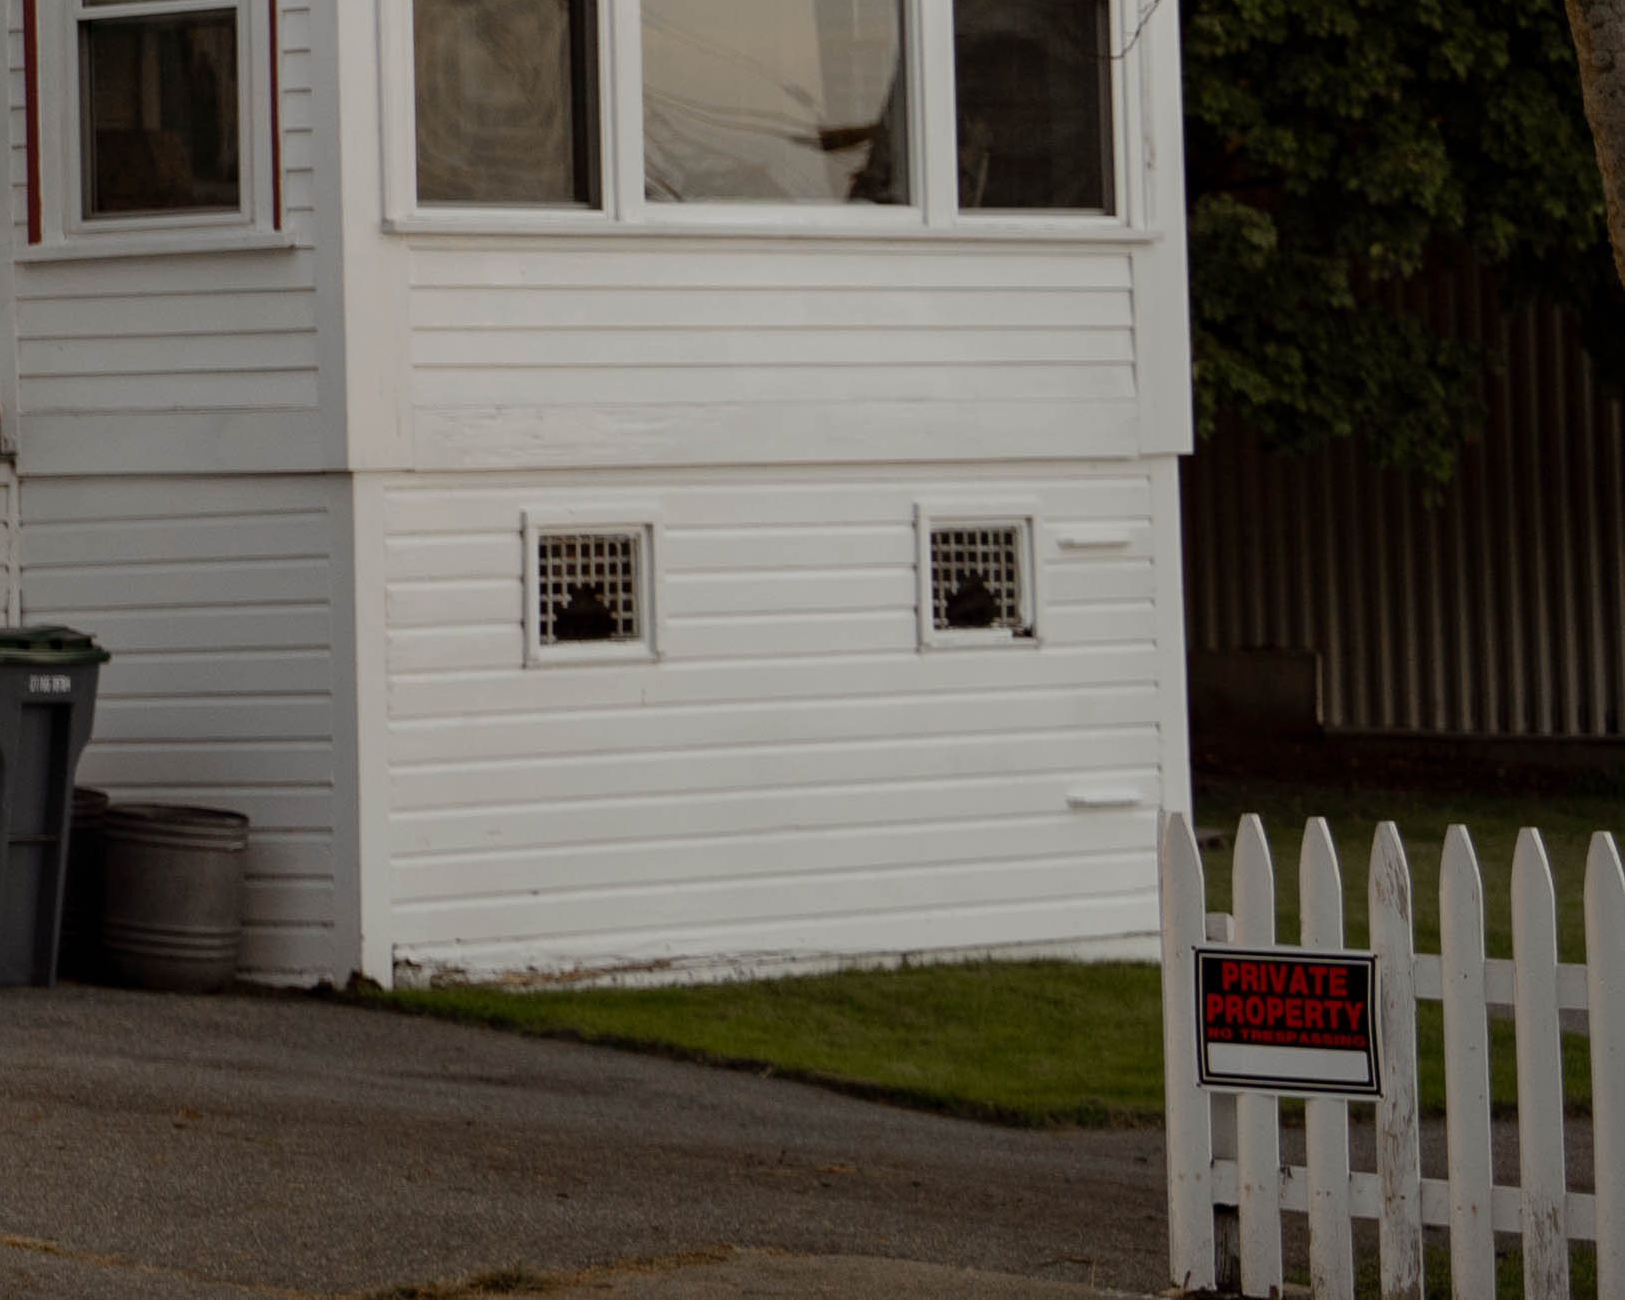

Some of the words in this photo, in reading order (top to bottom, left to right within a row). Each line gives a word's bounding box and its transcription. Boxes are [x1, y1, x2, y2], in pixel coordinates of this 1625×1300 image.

[1222, 961, 1348, 998] PRIVATE
[1206, 992, 1364, 1031] PROPERTY
[1207, 1026, 1232, 1040] NO
[1240, 1029, 1367, 1048] TRESPASSING
